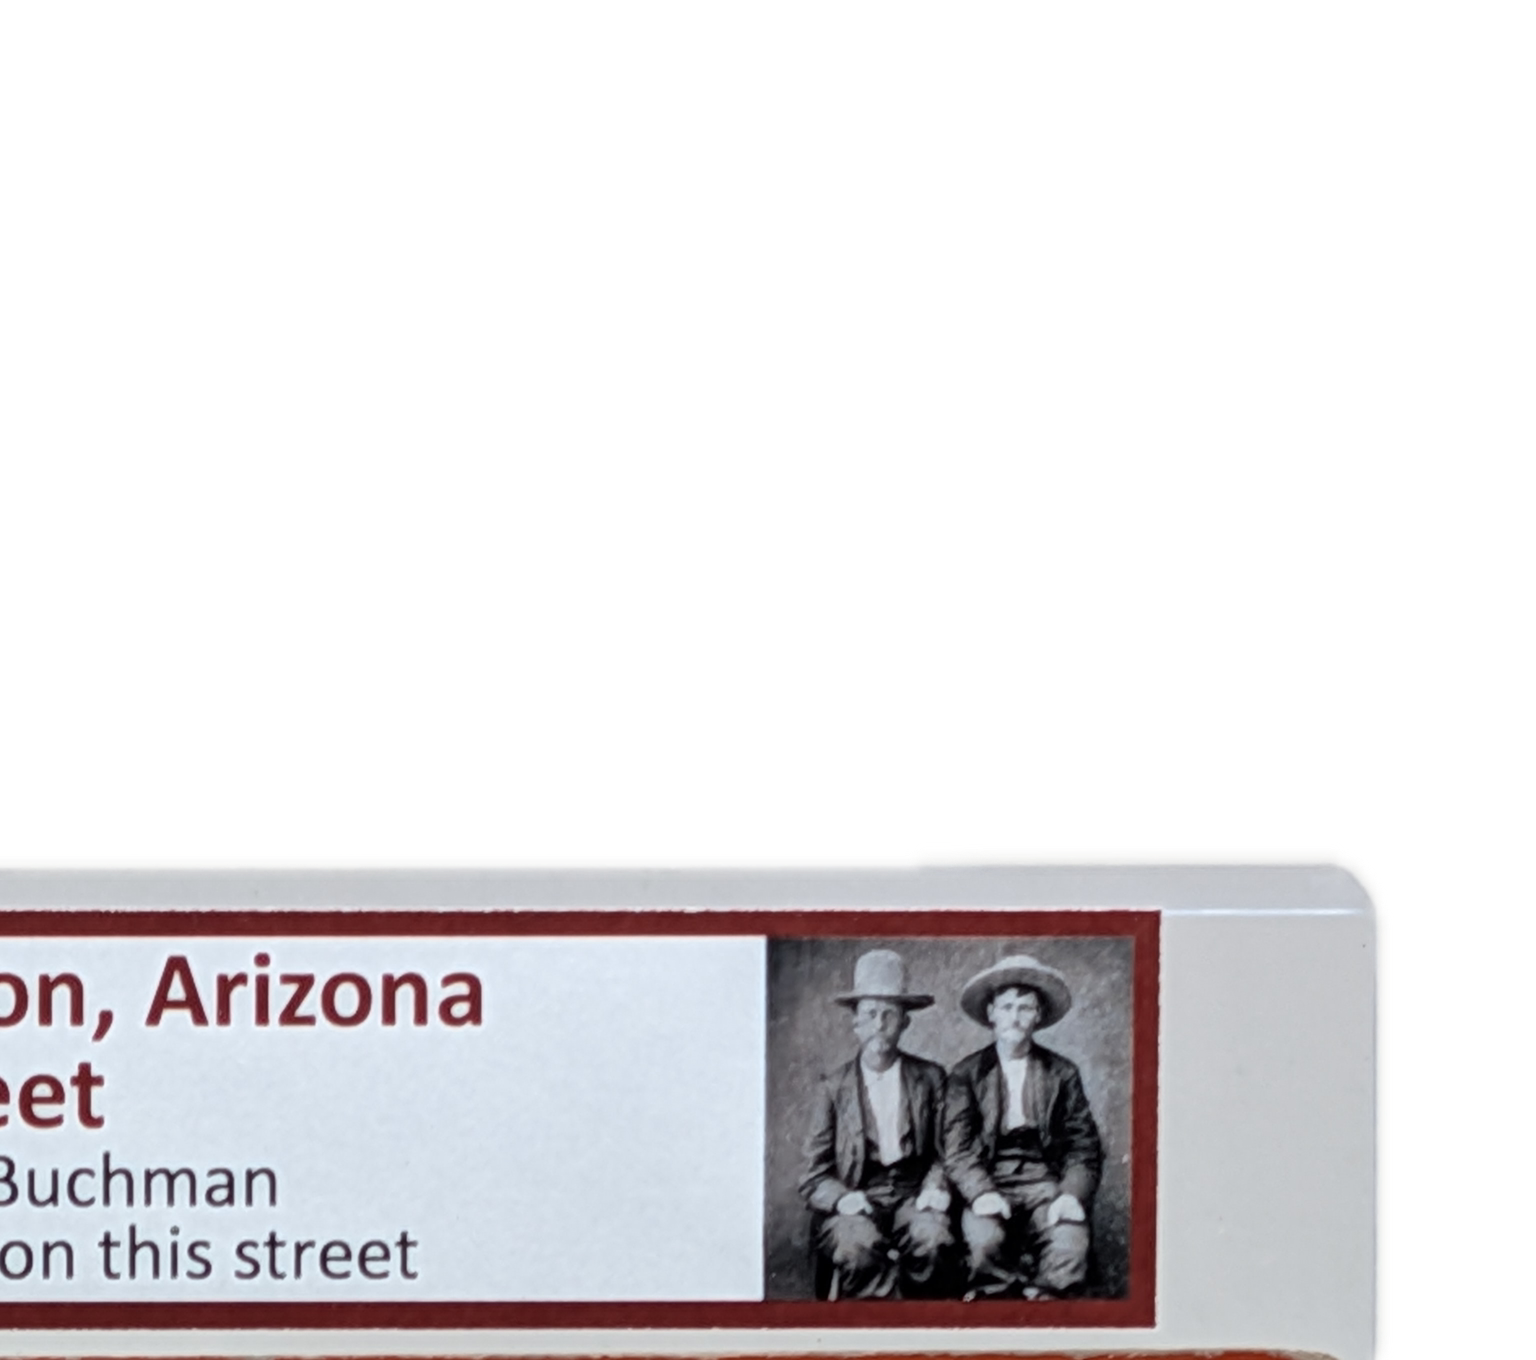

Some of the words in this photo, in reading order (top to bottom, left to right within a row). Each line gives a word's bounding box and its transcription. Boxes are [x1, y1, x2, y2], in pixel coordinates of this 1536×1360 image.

[145, 952, 483, 1027] Arizona
[97, 1224, 213, 1280] this
[234, 1231, 418, 1280] street
